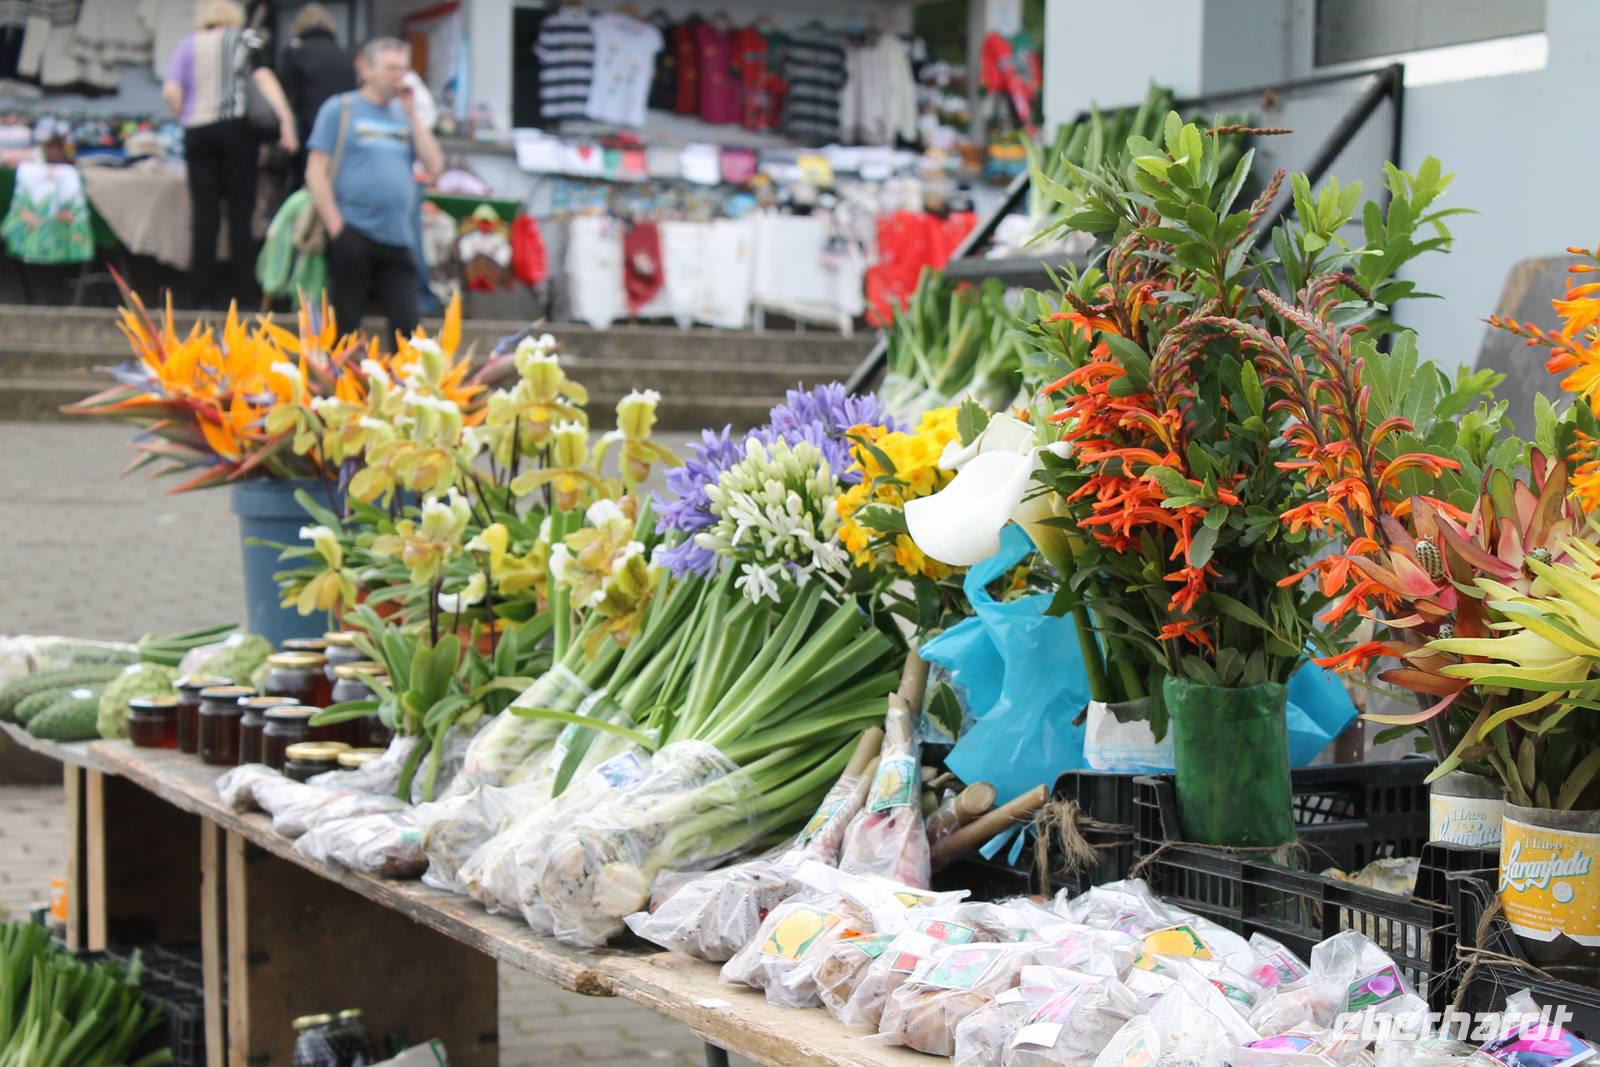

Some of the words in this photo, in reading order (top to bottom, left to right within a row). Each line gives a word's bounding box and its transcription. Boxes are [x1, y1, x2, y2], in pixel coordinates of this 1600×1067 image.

[1525, 837, 1531, 849] 1
[1533, 837, 1563, 850] Litro
[1499, 840, 1592, 892] Laranjada
